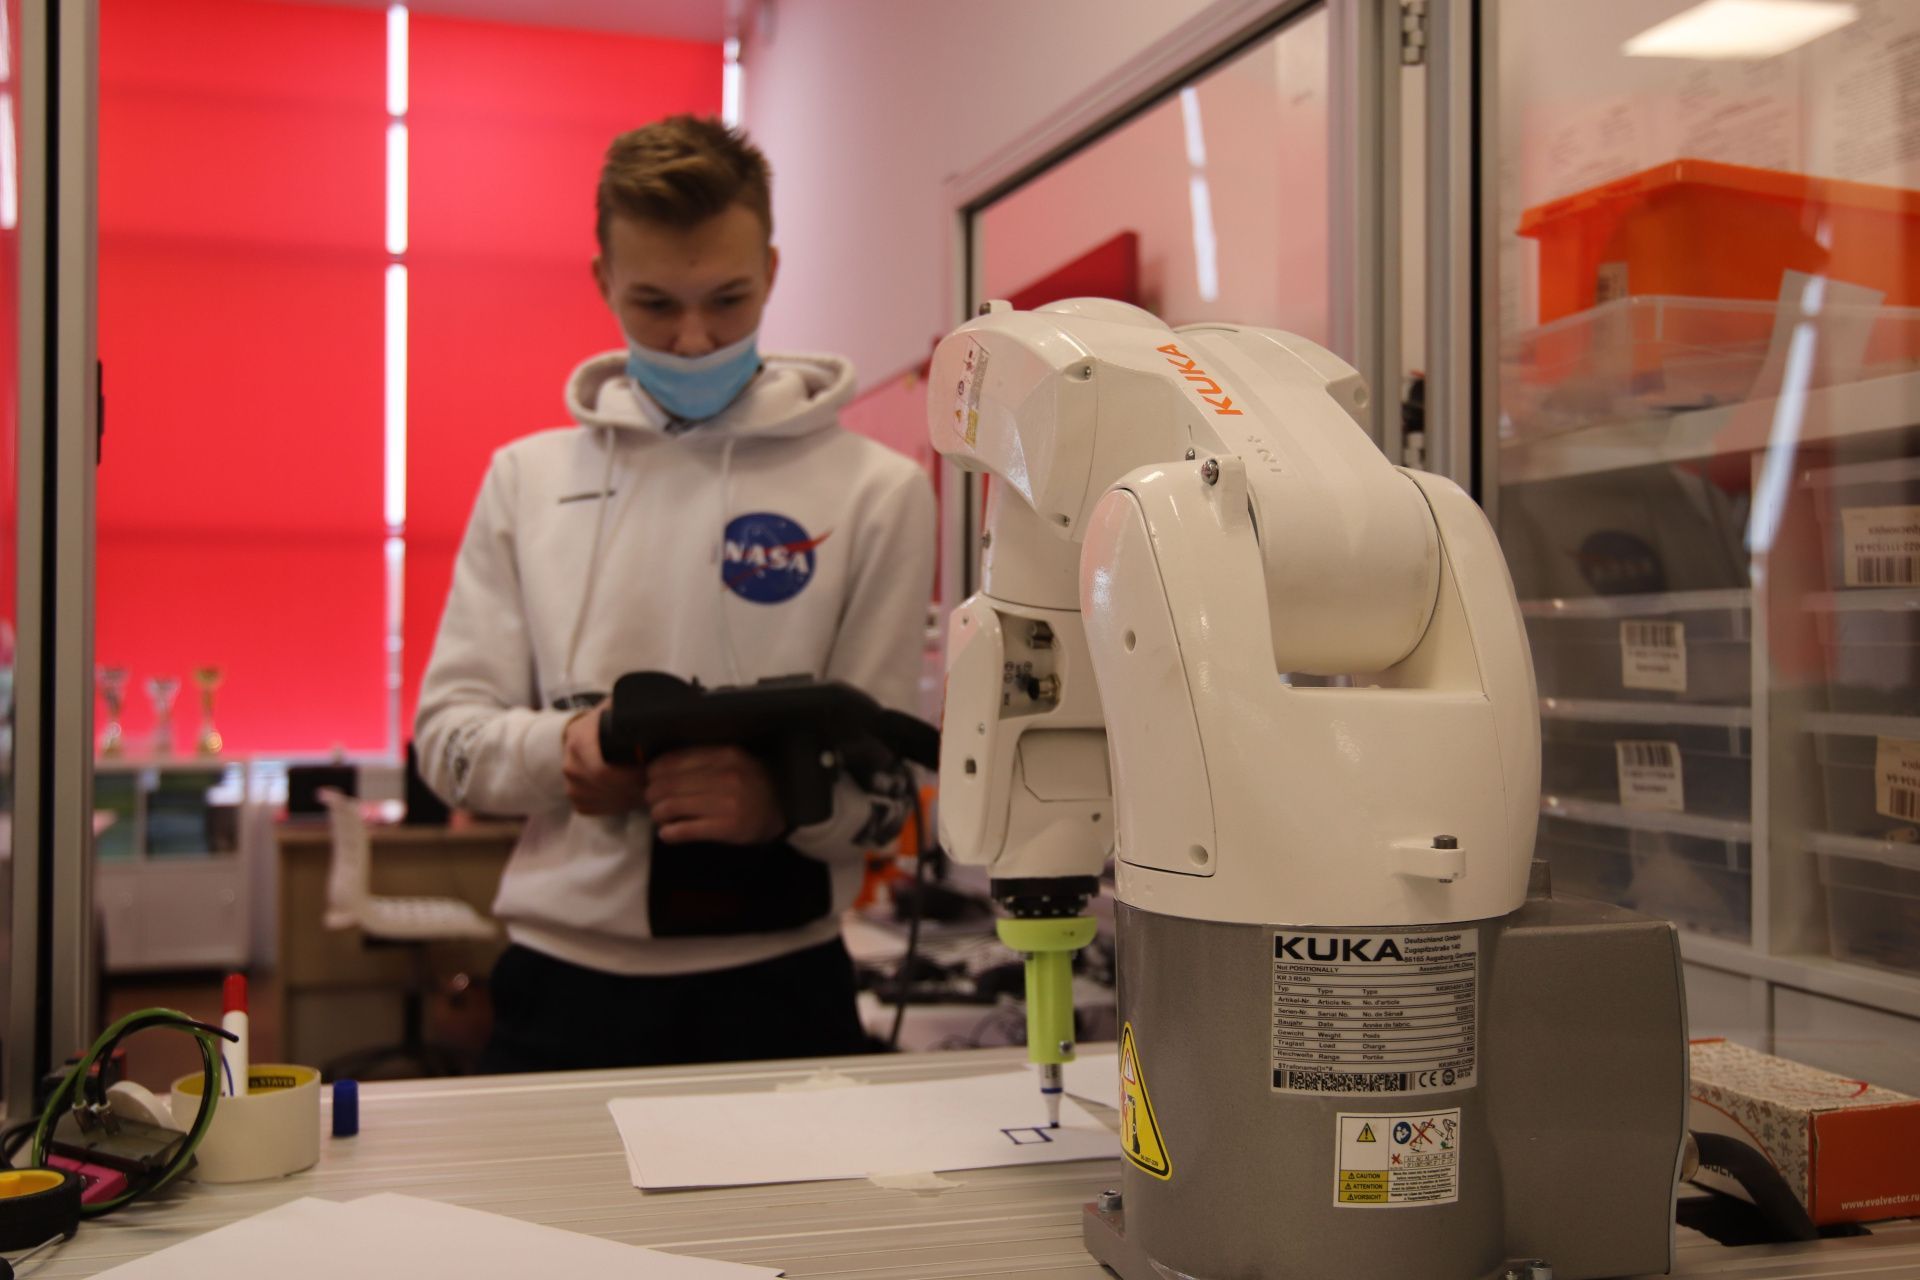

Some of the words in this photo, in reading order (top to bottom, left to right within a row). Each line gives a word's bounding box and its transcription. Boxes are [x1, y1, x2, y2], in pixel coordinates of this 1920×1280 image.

[1156, 344, 1244, 415] KUKA
[725, 540, 809, 574] NASA
[1404, 936, 1443, 944] Deutschland
[1275, 936, 1403, 962] KUKA
[1289, 965, 1340, 973] POSITIONALLY
[1278, 984, 1290, 992] Typ
[1278, 1018, 1304, 1027] Baujahr
[1278, 1029, 1304, 1037] Gewicht
[1317, 1032, 1341, 1040] Weight
[1278, 1039, 1305, 1047] Traglast
[1277, 1050, 1314, 1058] Reichweite
[260, 1079, 294, 1087] STAYER
[1419, 1071, 1437, 1087] CE
[1841, 1193, 1920, 1210] www.evolvector.ru
